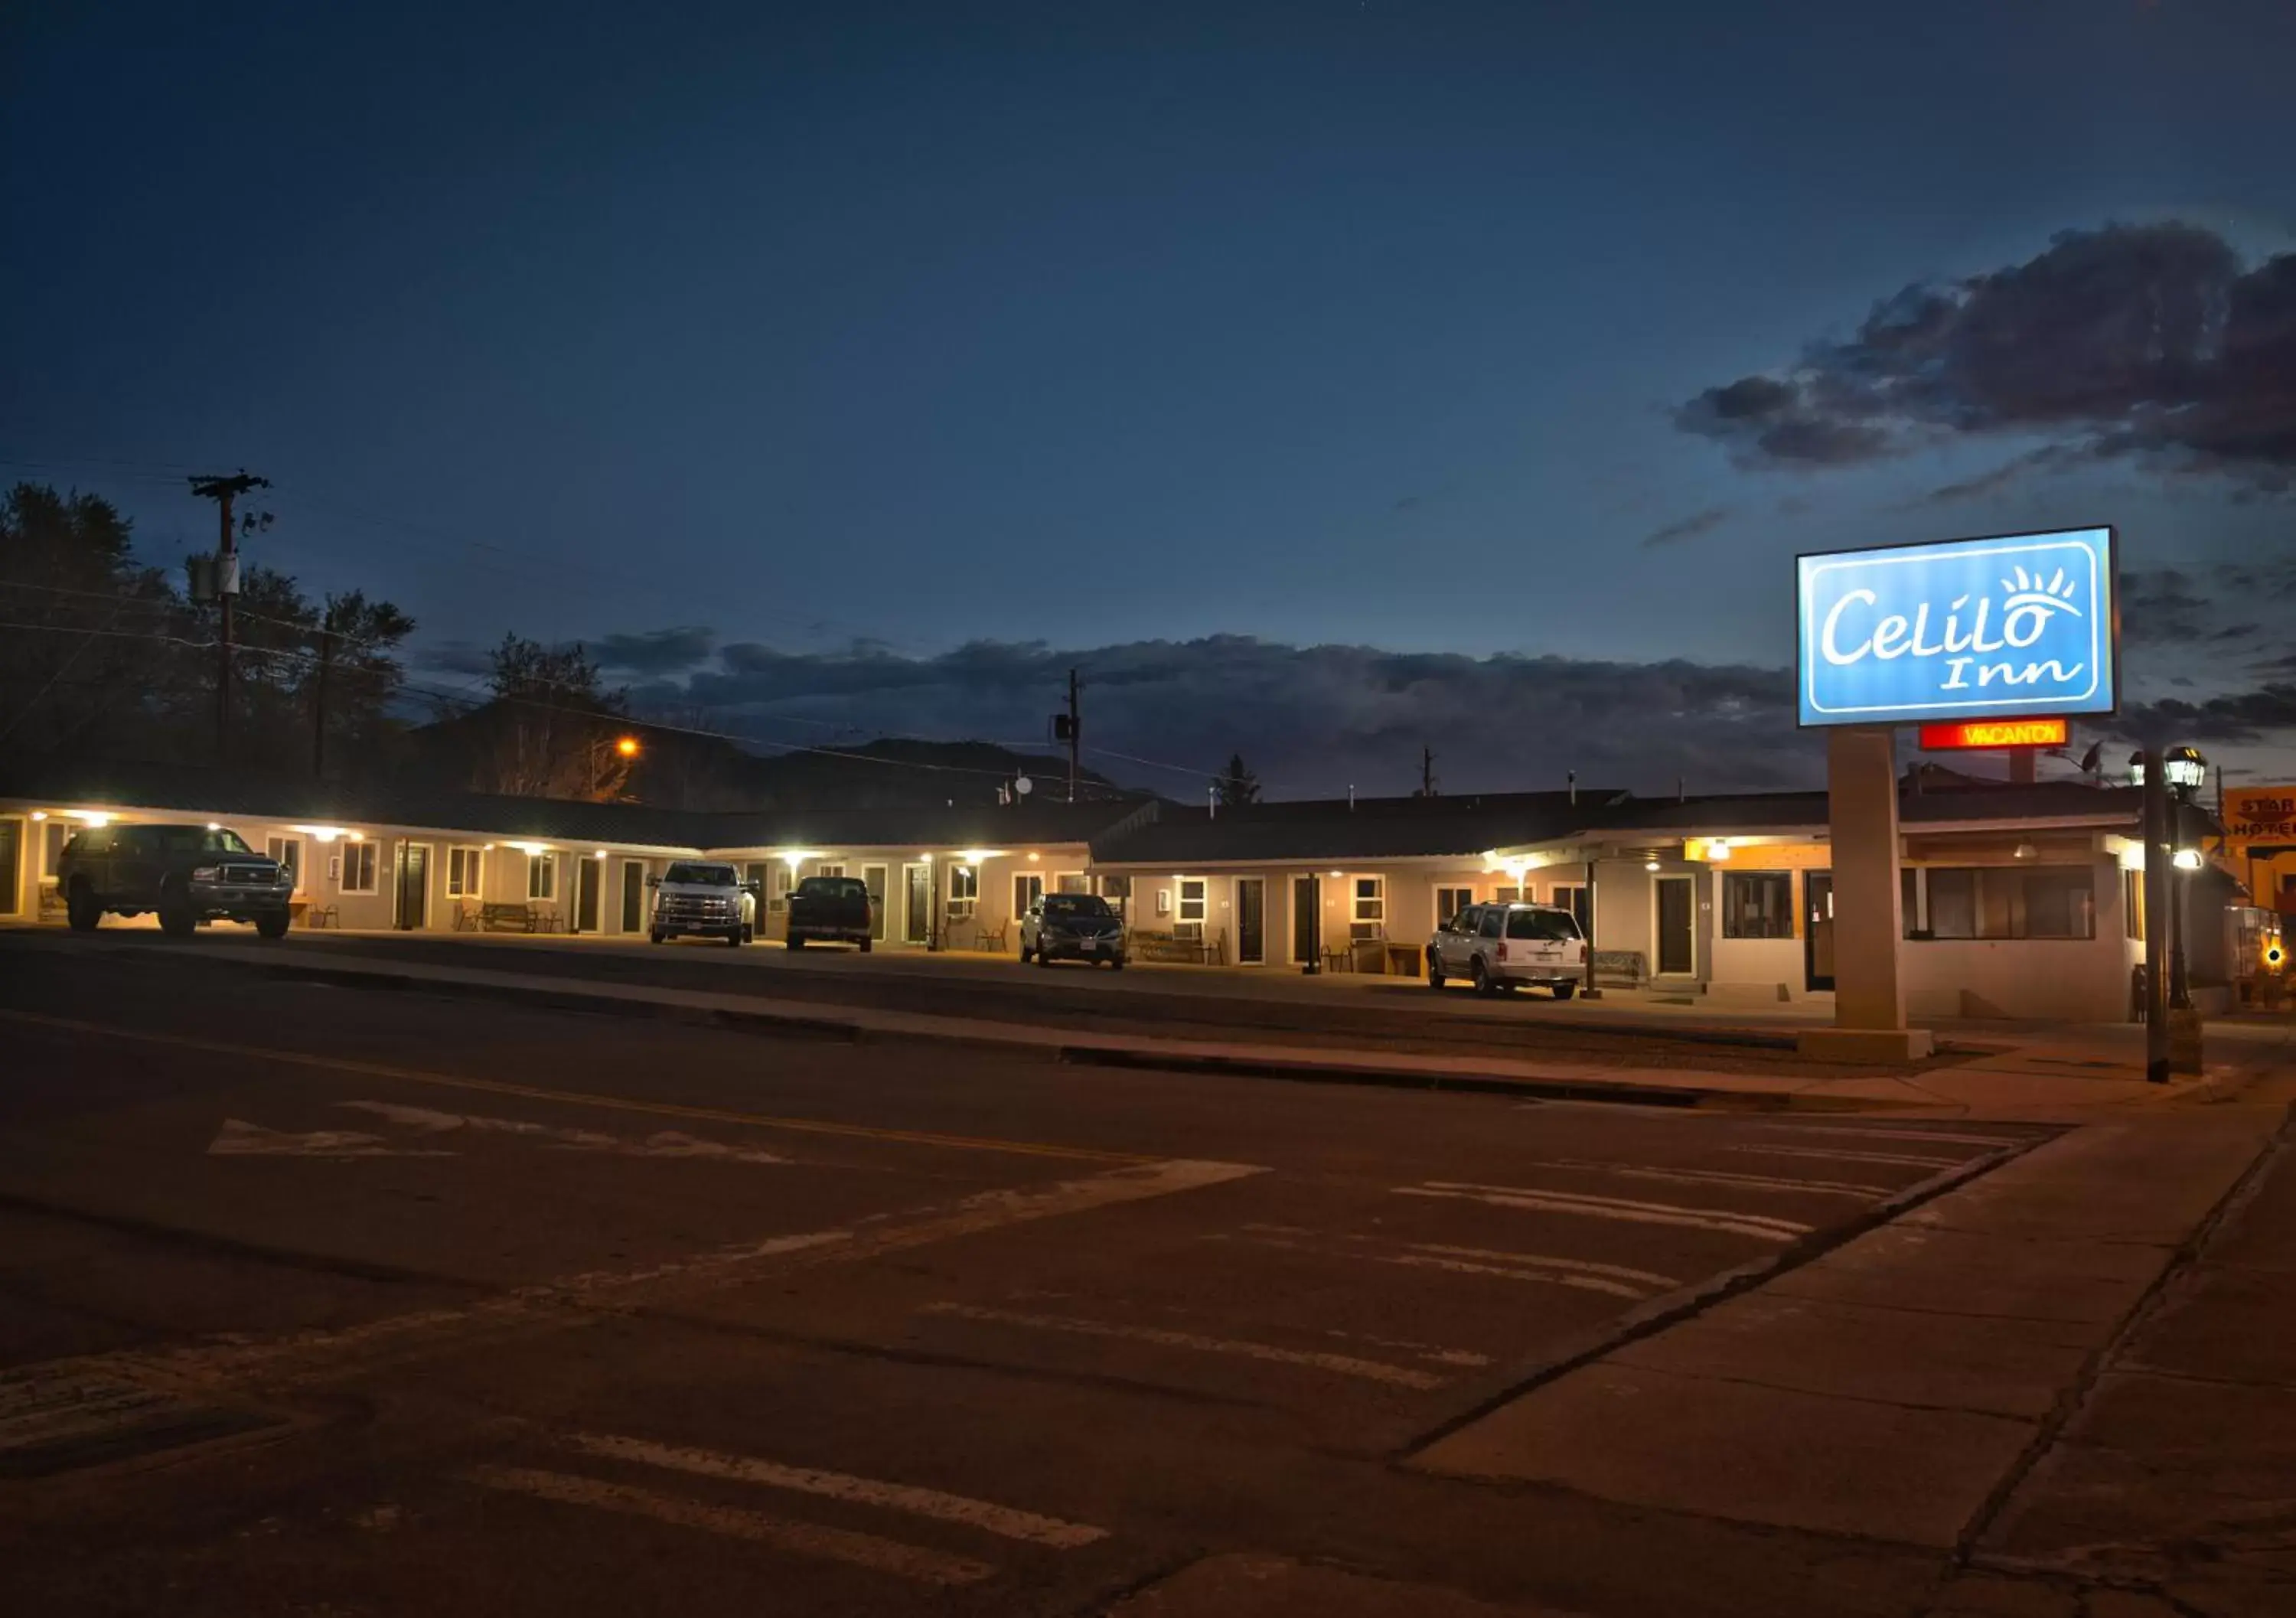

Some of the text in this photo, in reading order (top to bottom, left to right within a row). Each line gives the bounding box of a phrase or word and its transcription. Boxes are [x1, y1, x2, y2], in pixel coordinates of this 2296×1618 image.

[1940, 657, 2084, 690] Inn
[1965, 724, 2057, 745] VACANCY
[2240, 798, 2294, 812] STAR
